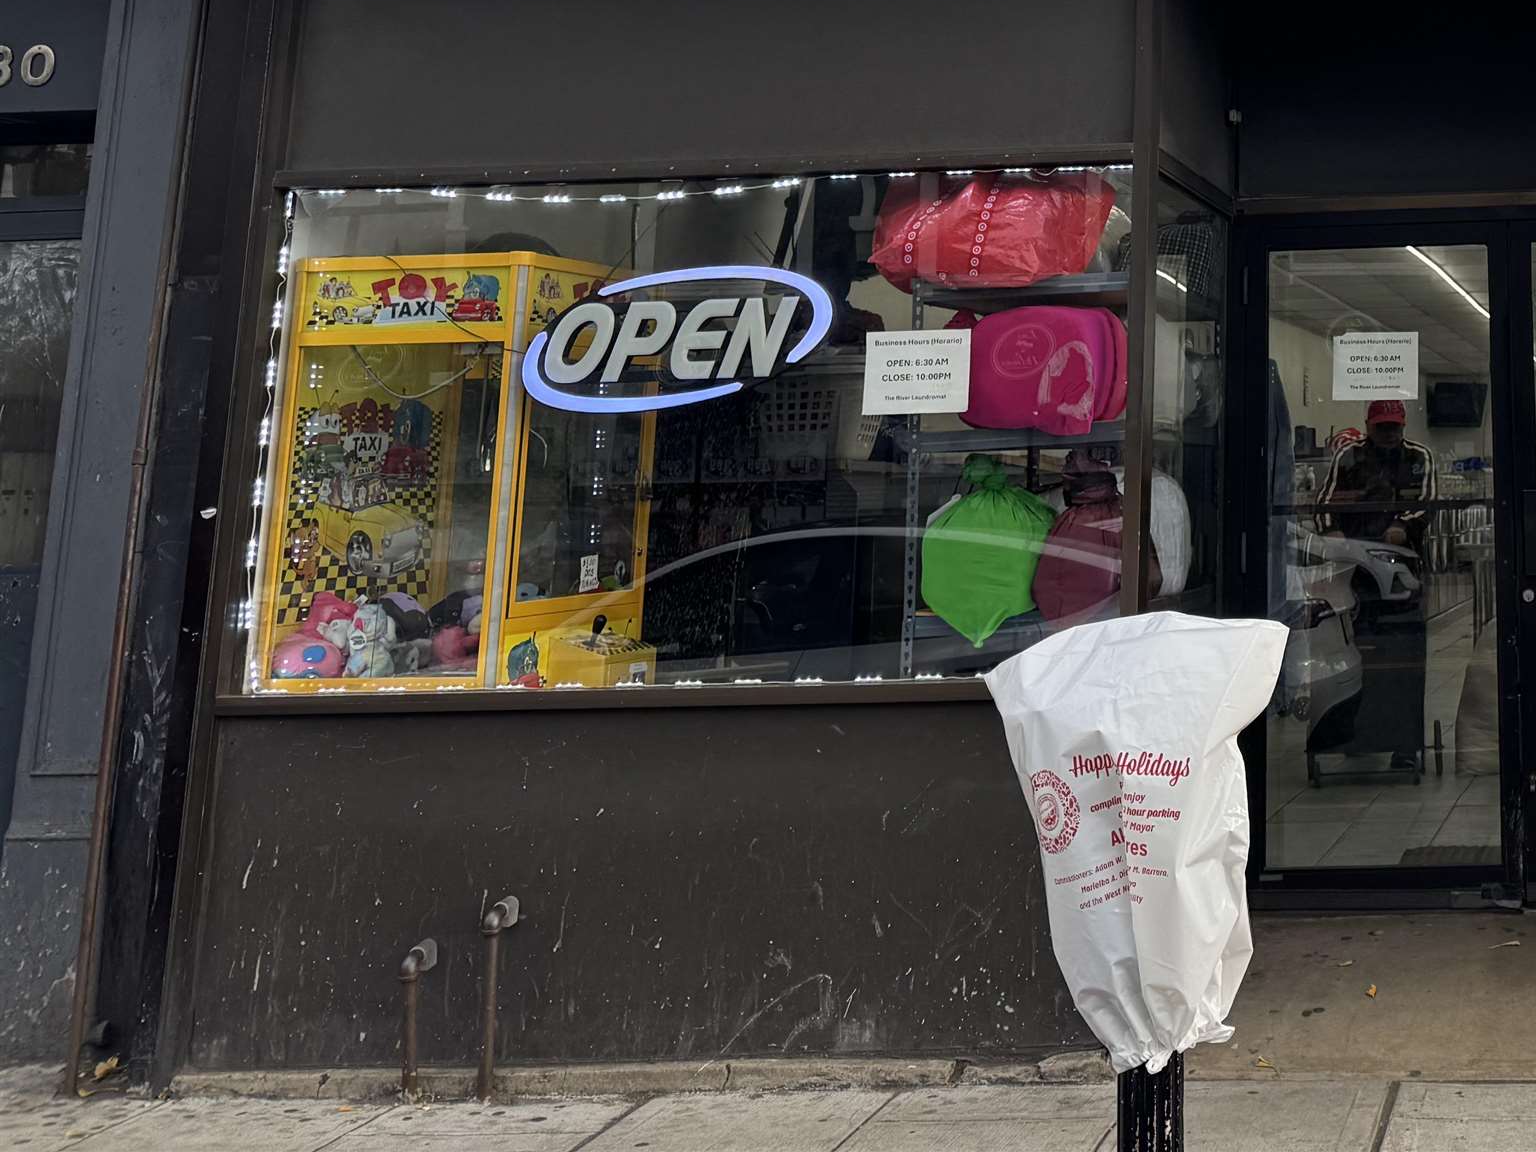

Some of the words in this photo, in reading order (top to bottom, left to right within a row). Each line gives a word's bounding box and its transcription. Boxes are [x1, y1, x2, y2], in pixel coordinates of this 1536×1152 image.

[371, 273, 459, 308] TOY
[389, 300, 436, 319] TAXI
[545, 295, 801, 384] OPEN
[874, 339, 907, 347] Business
[908, 338, 930, 346] Hours
[886, 359, 914, 367] OPEN:
[915, 358, 934, 367] 6:30
[934, 358, 949, 366] AM
[881, 373, 914, 382] CLOSE:
[352, 436, 383, 454] TAXI
[1116, 751, 1191, 787] Holidays
[1127, 806, 1146, 818] hour
[1147, 808, 1181, 821] parking
[1129, 821, 1156, 833] Mayor
[1094, 860, 1115, 873] Adam
[1104, 887, 1122, 901] West
